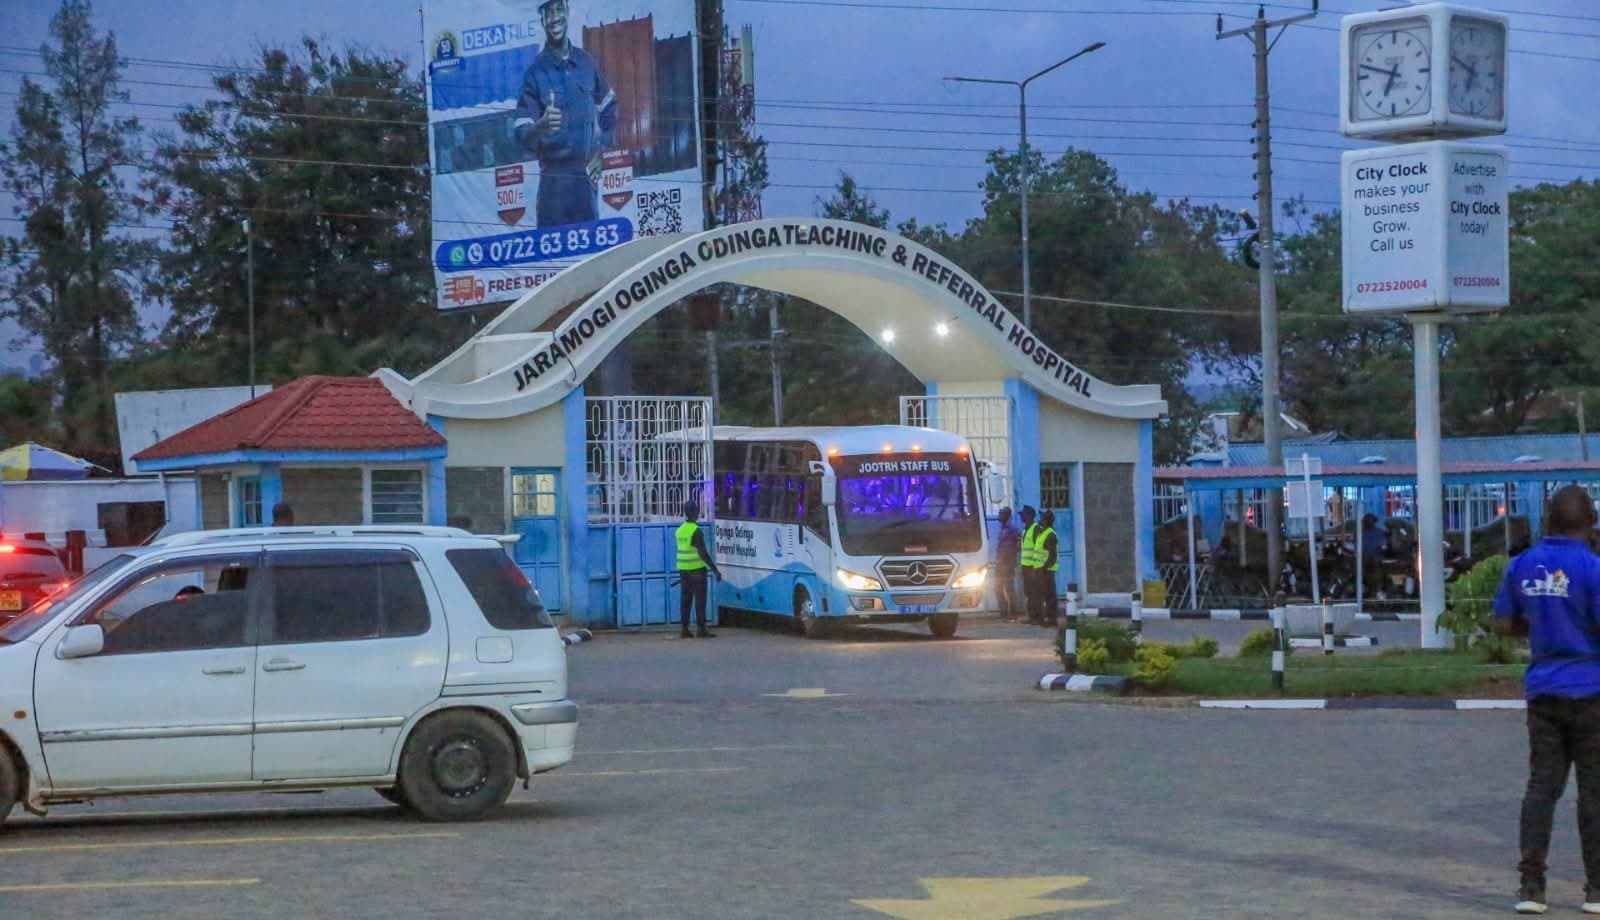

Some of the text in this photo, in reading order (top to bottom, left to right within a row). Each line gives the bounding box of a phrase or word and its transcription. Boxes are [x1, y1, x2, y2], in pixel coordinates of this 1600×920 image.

[1356, 162, 1427, 181] City Clock
[1453, 162, 1496, 176] Advertise
[1354, 182, 1430, 199] makes your
[1464, 183, 1485, 195] with
[497, 190, 524, 206] 500/=
[1364, 202, 1420, 216] business
[1450, 200, 1501, 216] City Clock
[1373, 220, 1410, 233] Grow.
[1460, 221, 1489, 237] today!
[489, 225, 619, 262] 0722 63 83 83
[1370, 238, 1414, 252] Call us
[488, 277, 521, 293] FREE
[1357, 279, 1427, 293] 0722520004
[513, 224, 1092, 398] JARAMOGI OGINGA ODINGA TEACHING & REFERRAL HOSPITAL
[859, 460, 951, 473] JOOTRH STAFF BUS
